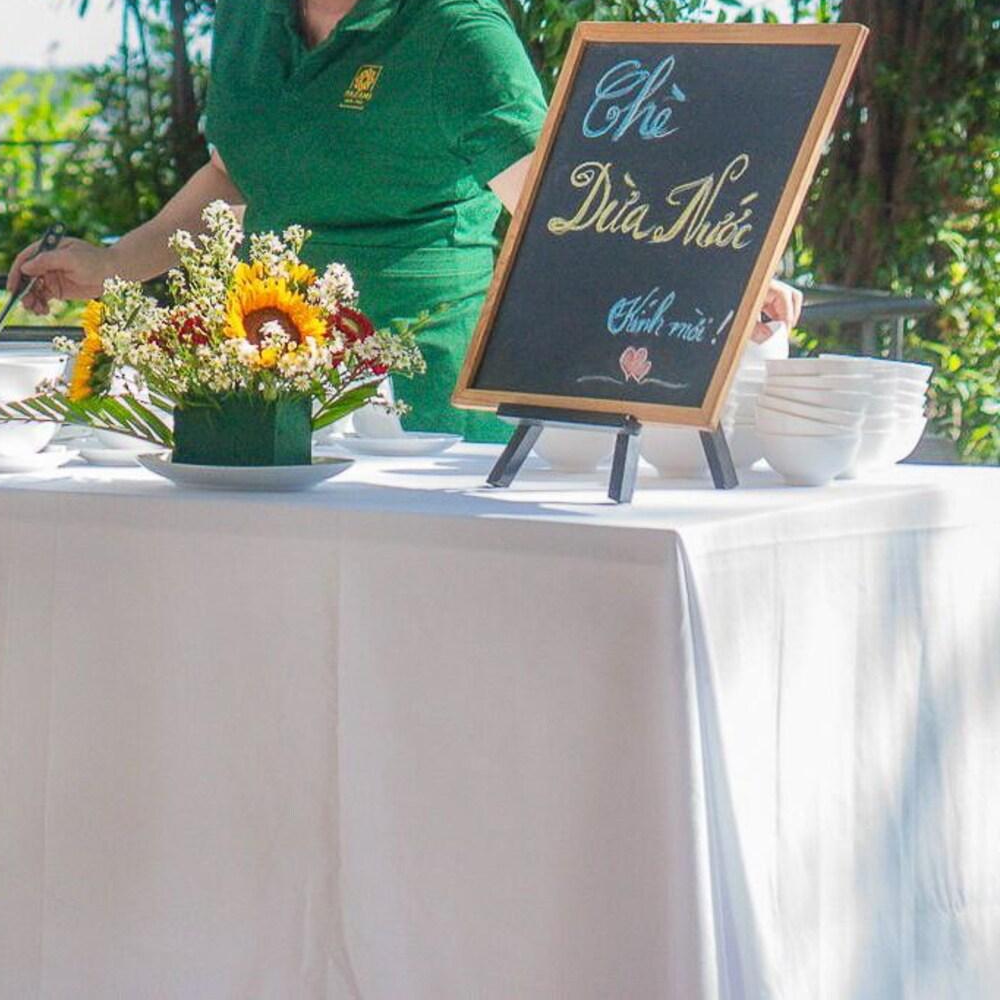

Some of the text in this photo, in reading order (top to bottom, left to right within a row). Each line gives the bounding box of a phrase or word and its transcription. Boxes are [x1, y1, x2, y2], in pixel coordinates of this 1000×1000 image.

[582, 55, 686, 142] Chè
[547, 153, 759, 249] Dừa Nước
